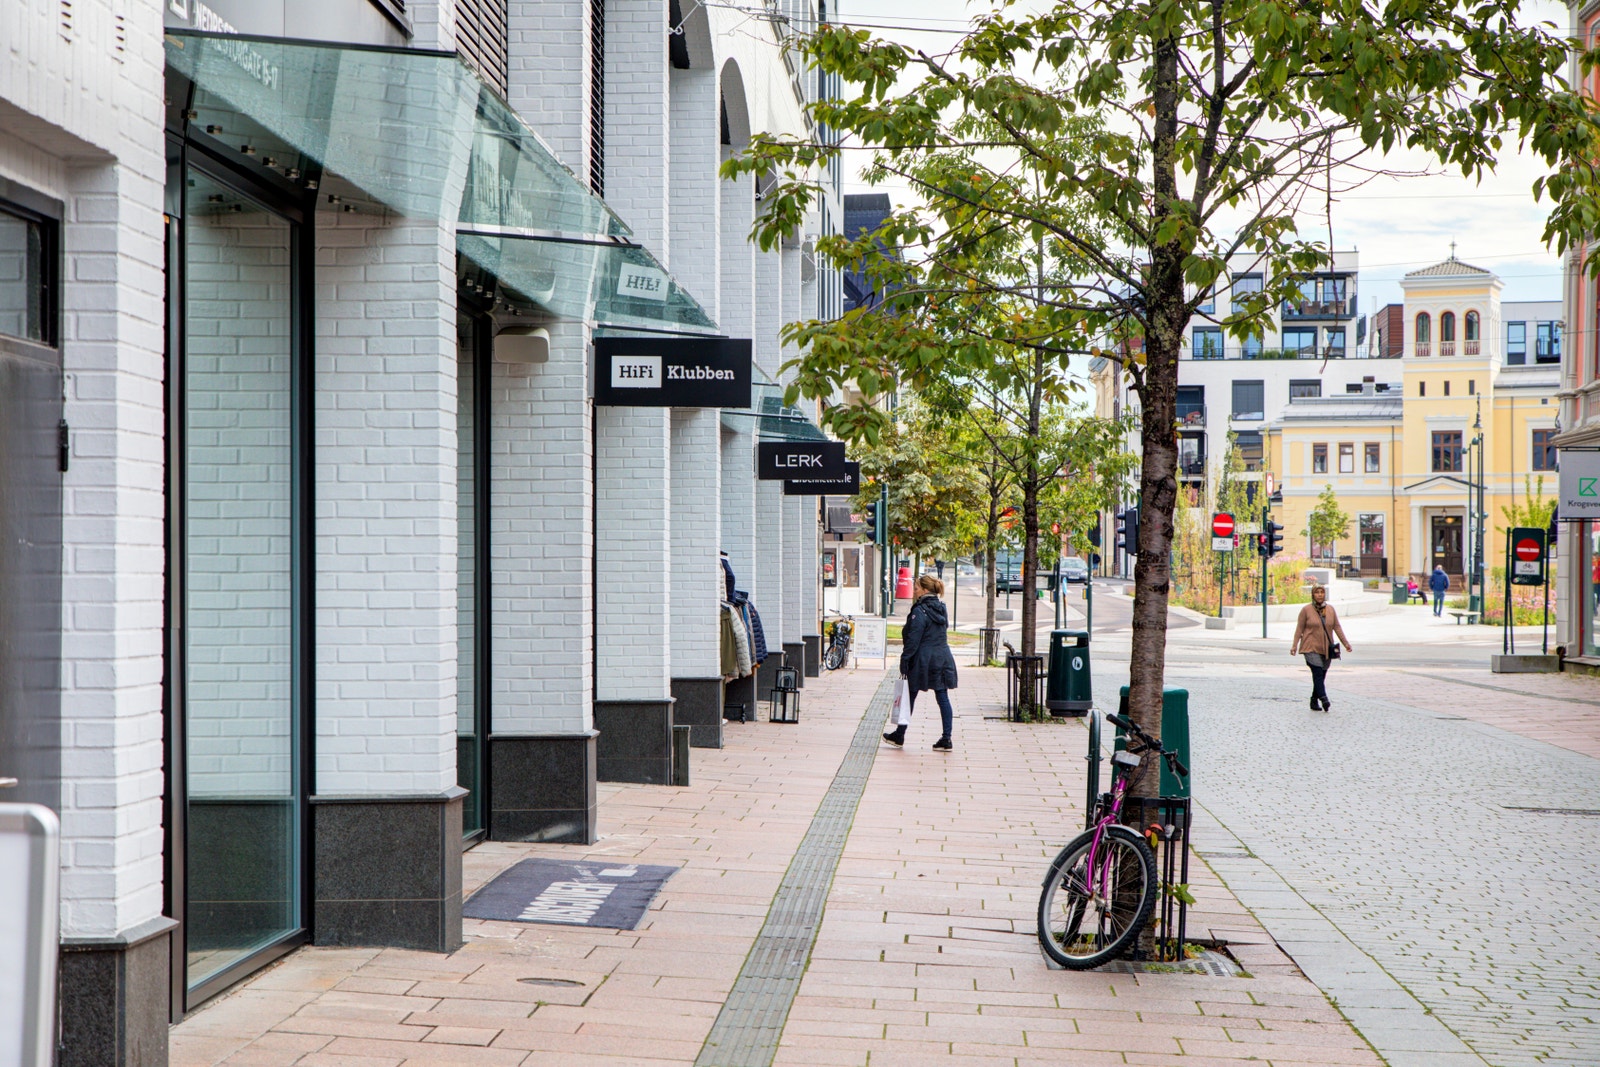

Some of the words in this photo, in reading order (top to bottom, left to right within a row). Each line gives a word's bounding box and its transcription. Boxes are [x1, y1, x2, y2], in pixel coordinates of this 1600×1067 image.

[619, 365, 653, 378] HiFi
[667, 365, 735, 380] Klubben
[775, 454, 823, 467] LERK
[516, 881, 618, 924] DISCOVER
